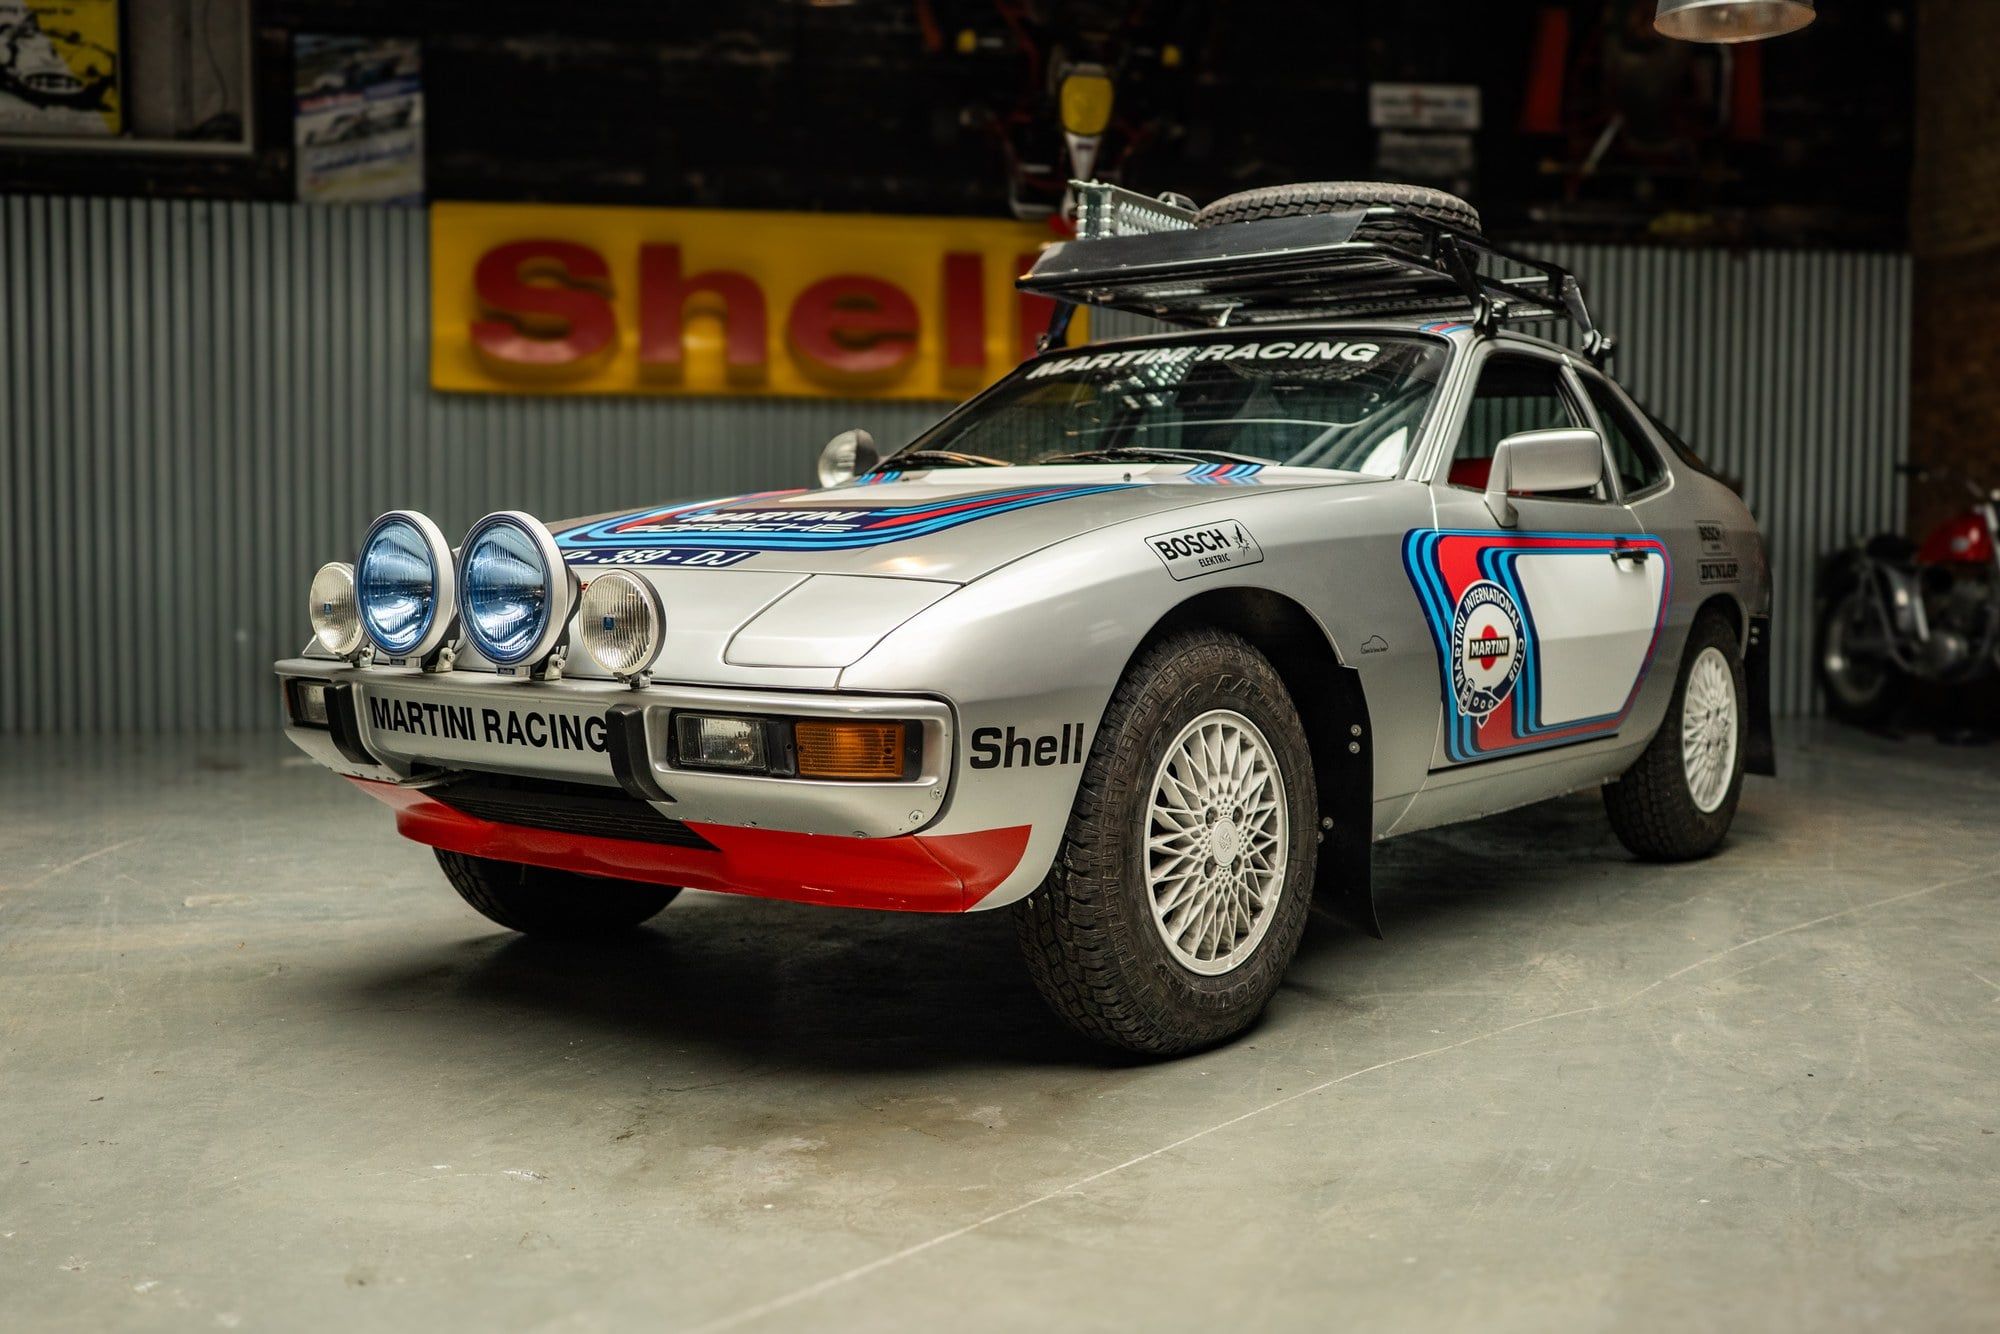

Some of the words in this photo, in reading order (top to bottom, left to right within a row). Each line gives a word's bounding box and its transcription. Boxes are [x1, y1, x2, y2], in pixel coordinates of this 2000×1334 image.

[471, 238, 1057, 371] Shell
[1026, 346, 1198, 380] MARTINI
[1195, 341, 1380, 362] RACING
[616, 523, 861, 534] PORSCHE
[679, 511, 871, 523] MARTINI
[1154, 528, 1232, 561] BOSCH
[1199, 553, 1231, 568] ELEKTRIC
[1454, 611, 1466, 690] MARTINI
[1464, 586, 1520, 630] INTERNATIONAL
[1509, 638, 1525, 683] CLUB
[1470, 639, 1508, 657] MARTINI
[369, 696, 477, 741] MARTINI
[481, 708, 609, 753] RACING
[969, 722, 1084, 770] Shell
